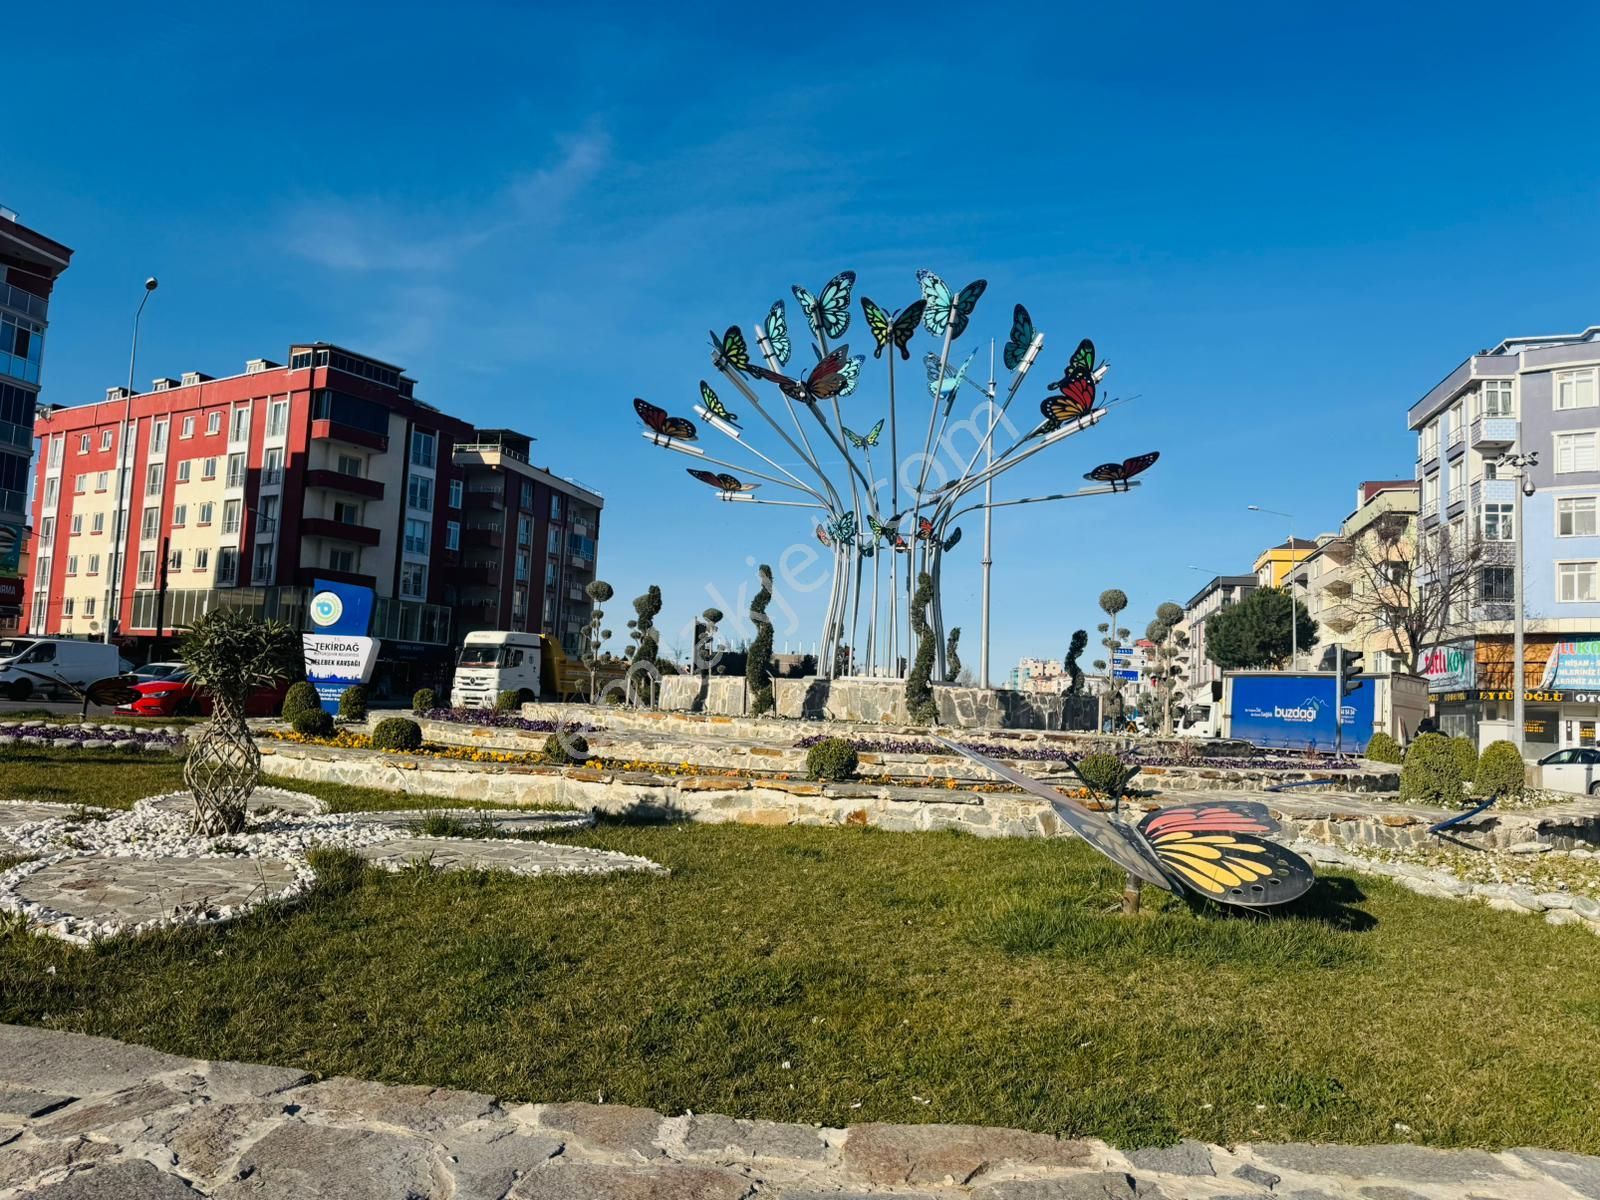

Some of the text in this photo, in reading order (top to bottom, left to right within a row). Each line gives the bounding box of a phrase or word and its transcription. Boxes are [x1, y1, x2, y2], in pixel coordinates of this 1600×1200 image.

[314, 641, 360, 653] TEKİRDAĞ
[1575, 693, 1600, 703] OT
[1274, 705, 1317, 722] buzdağı
